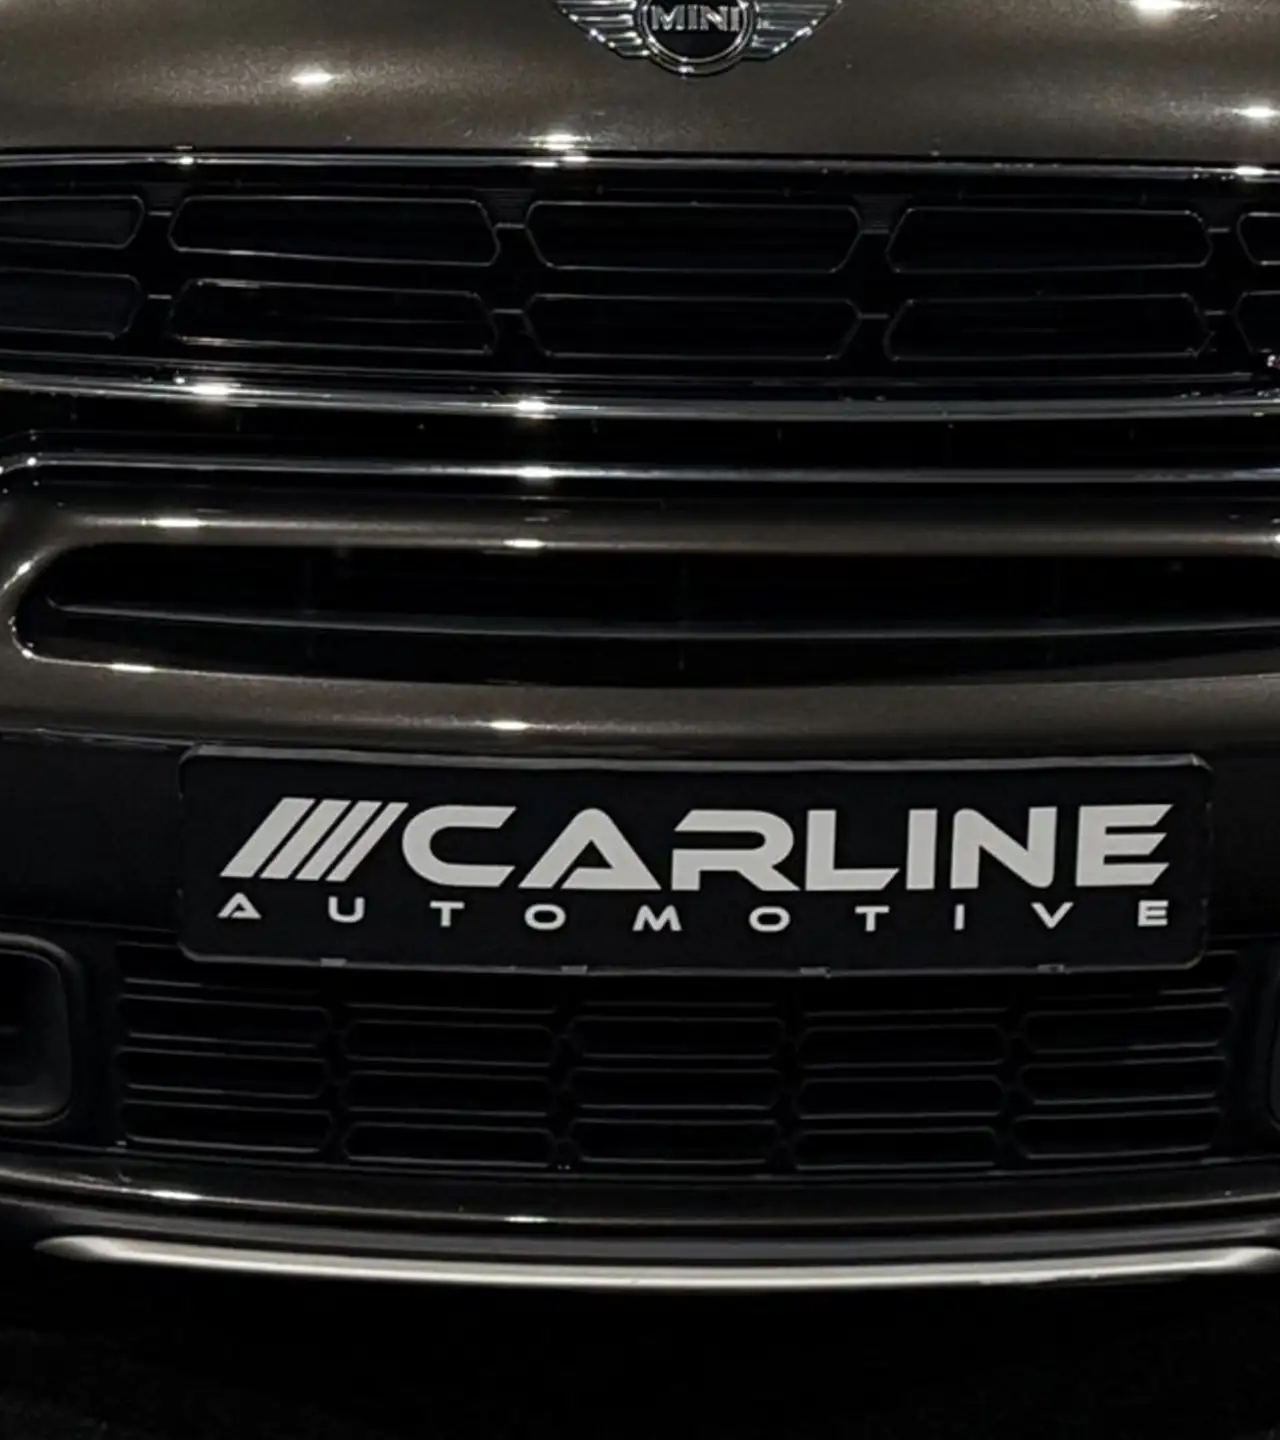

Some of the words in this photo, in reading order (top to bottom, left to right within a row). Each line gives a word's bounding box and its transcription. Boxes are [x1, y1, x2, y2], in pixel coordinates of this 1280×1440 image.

[651, 4, 740, 32] MINI
[401, 803, 1174, 892] CARLINE
[218, 892, 1169, 933] AUTOMOTIVE
